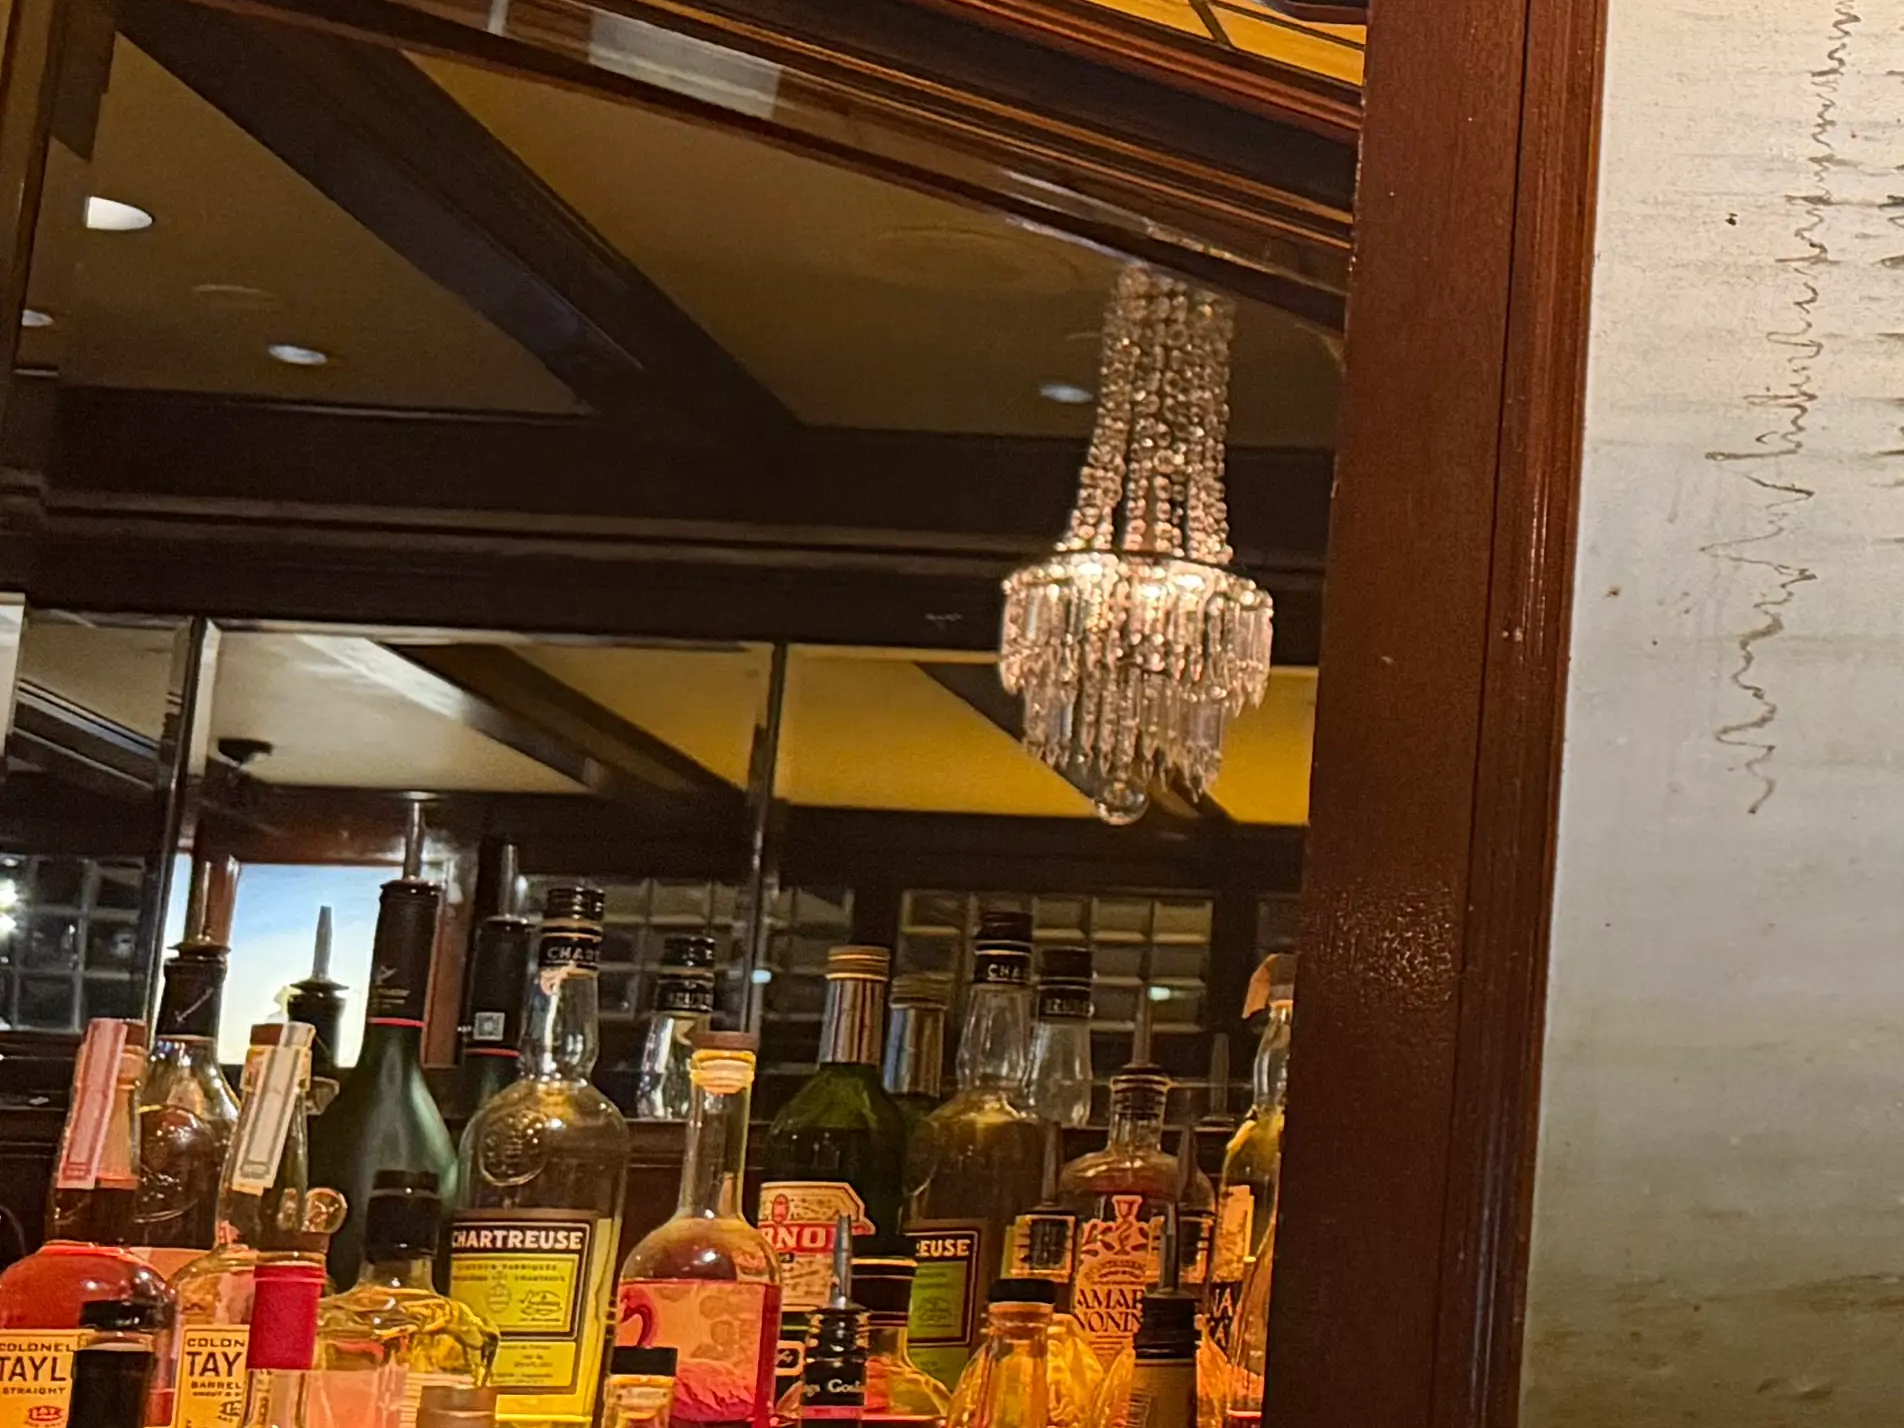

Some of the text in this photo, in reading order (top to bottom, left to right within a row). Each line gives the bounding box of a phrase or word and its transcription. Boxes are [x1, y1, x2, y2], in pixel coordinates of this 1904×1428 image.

[451, 1229, 584, 1250] CHARTREUSE
[761, 1227, 827, 1250] RNO
[915, 1239, 972, 1258] EUSE
[1077, 1287, 1144, 1311] AMAR
[1074, 1310, 1143, 1334] NONIN
[0, 1341, 74, 1354] COLONEL
[186, 1337, 246, 1349] COLON
[0, 1355, 68, 1383] TAYL
[186, 1351, 244, 1378] TAY
[2, 1385, 67, 1396] STRAIGHT
